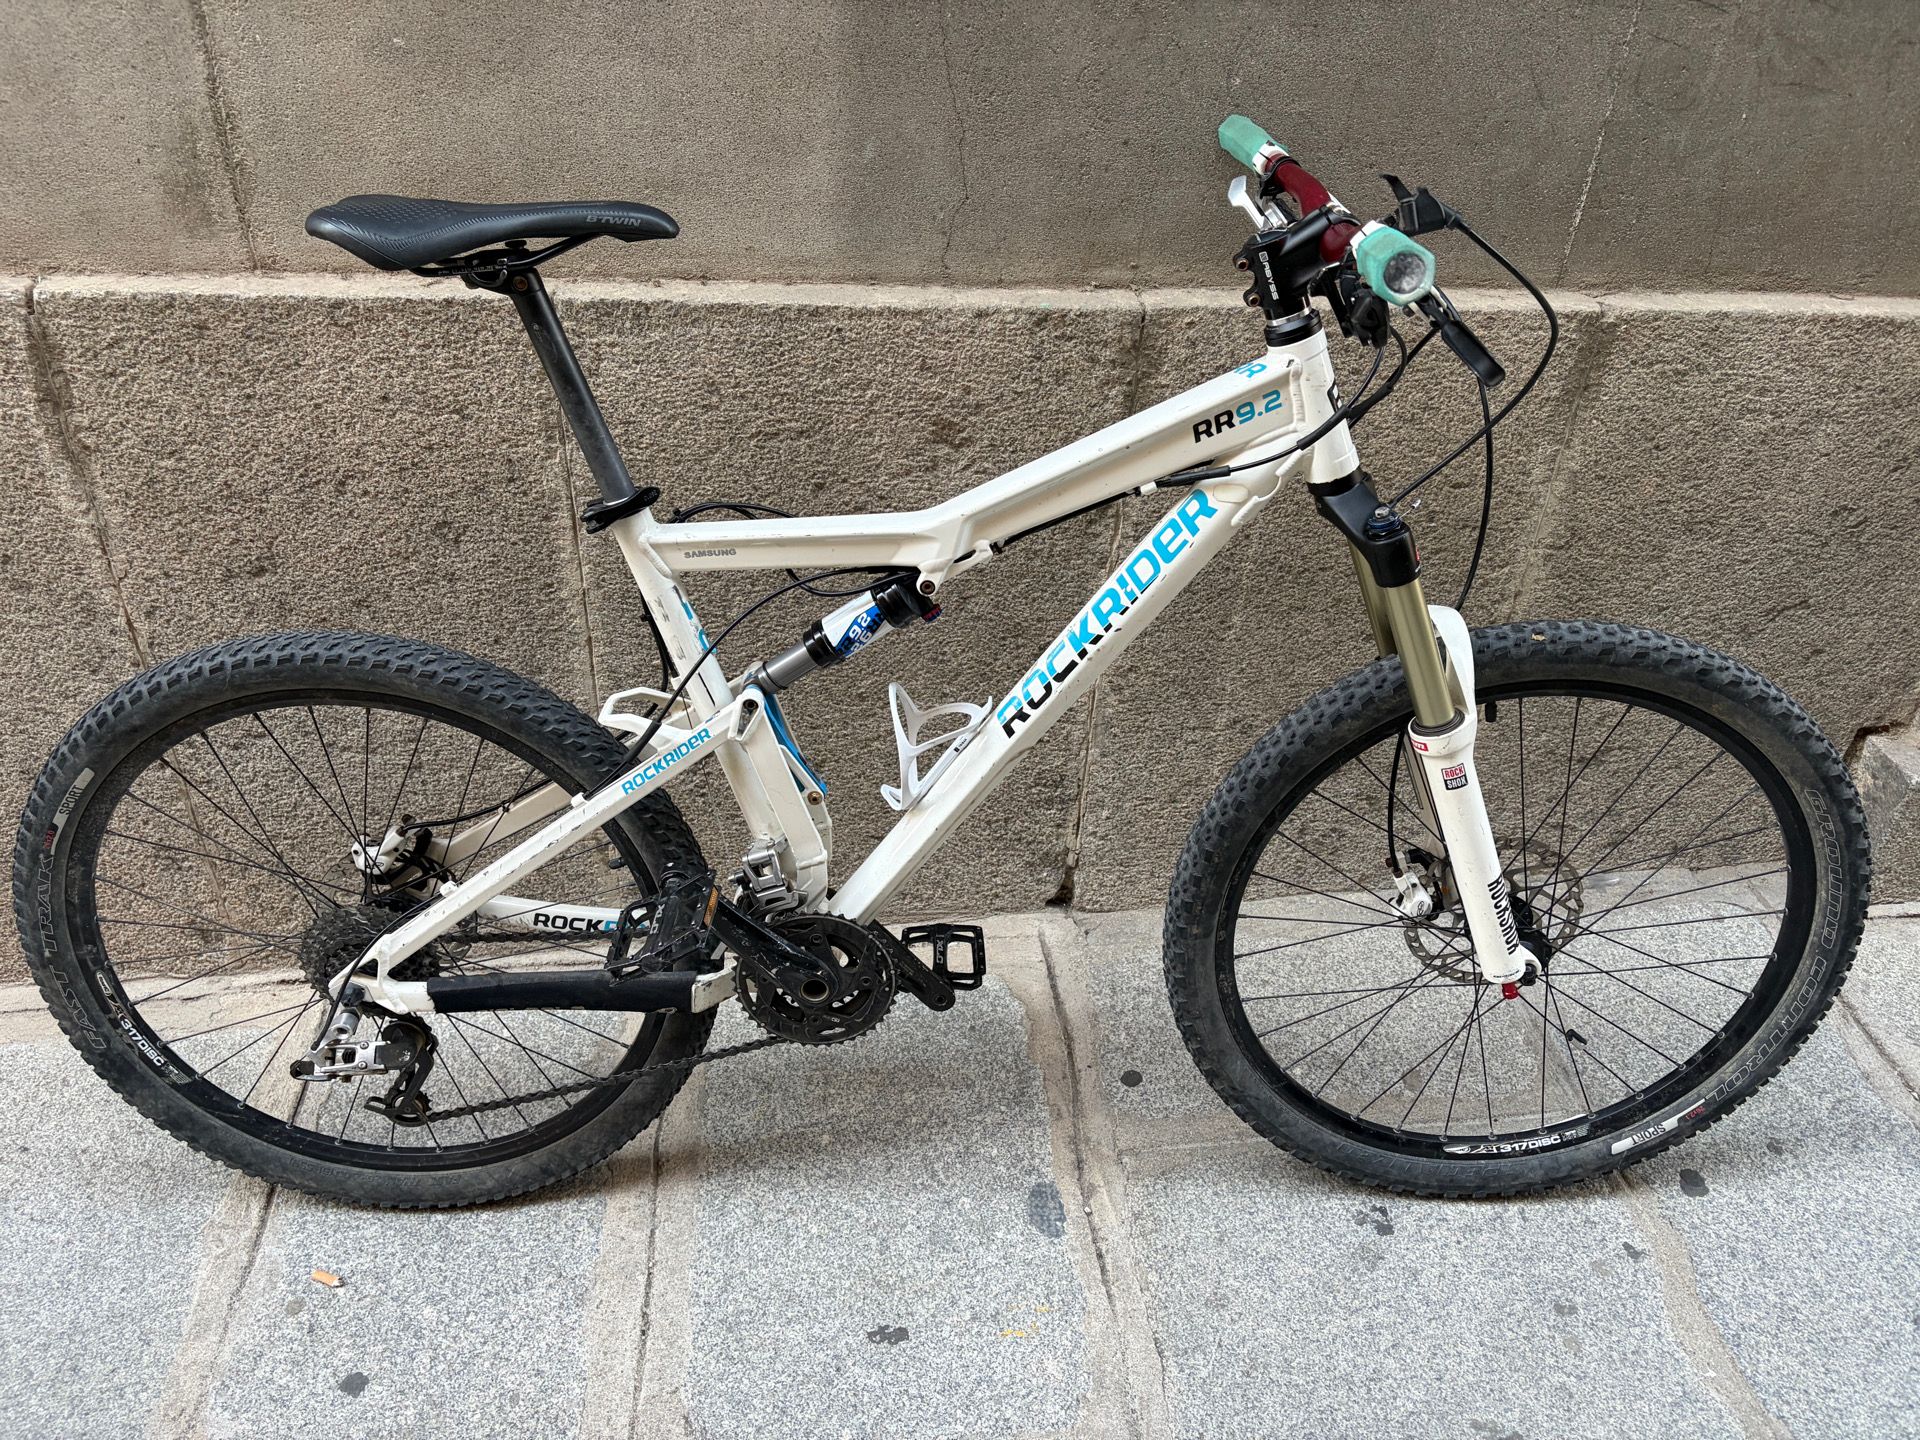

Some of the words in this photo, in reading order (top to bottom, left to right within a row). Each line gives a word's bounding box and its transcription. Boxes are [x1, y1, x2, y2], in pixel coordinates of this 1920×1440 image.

[1263, 262, 1279, 300] ABYSS
[1192, 389, 1283, 444] RR9.2
[684, 548, 737, 559] SAMSUNG
[996, 488, 1219, 739] ROCKRIDER
[621, 727, 712, 796] ROCKRIDER
[1444, 765, 1464, 779] ROCK
[1446, 775, 1466, 789] SHOX
[58, 784, 86, 816] SPORT
[1804, 789, 1843, 949] GROUND
[38, 855, 57, 953] TRAK
[49, 965, 107, 1049] FAST
[1704, 955, 1828, 1102] CONTROL
[1631, 1123, 1667, 1146] SPORT
